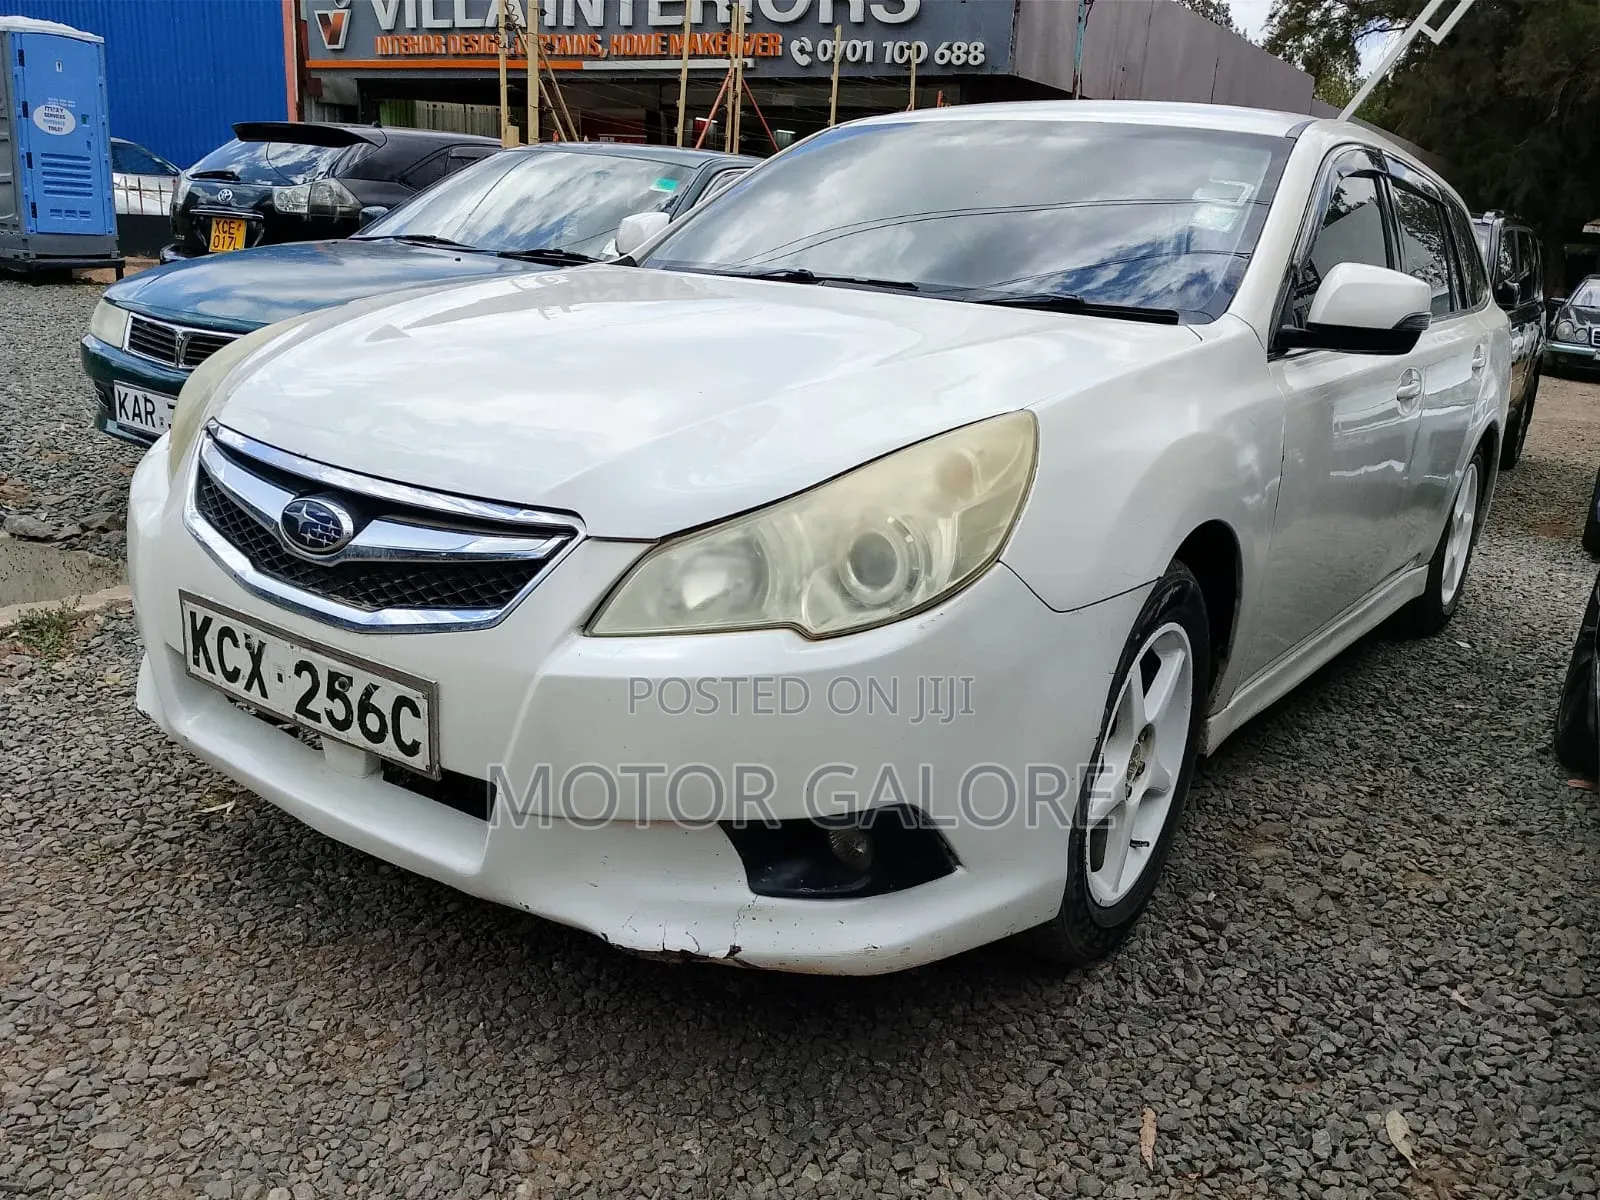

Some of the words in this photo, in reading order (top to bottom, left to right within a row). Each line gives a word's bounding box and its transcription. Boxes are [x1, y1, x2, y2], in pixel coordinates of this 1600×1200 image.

[375, 34, 446, 55] INTERIOR
[609, 33, 668, 56] HOME
[817, 39, 874, 63] 0701
[883, 41, 928, 64] 100
[934, 41, 986, 66] 688
[214, 219, 236, 235] XCE
[117, 390, 156, 427] KAR
[189, 610, 269, 700] KCX
[293, 660, 422, 758] 256C
